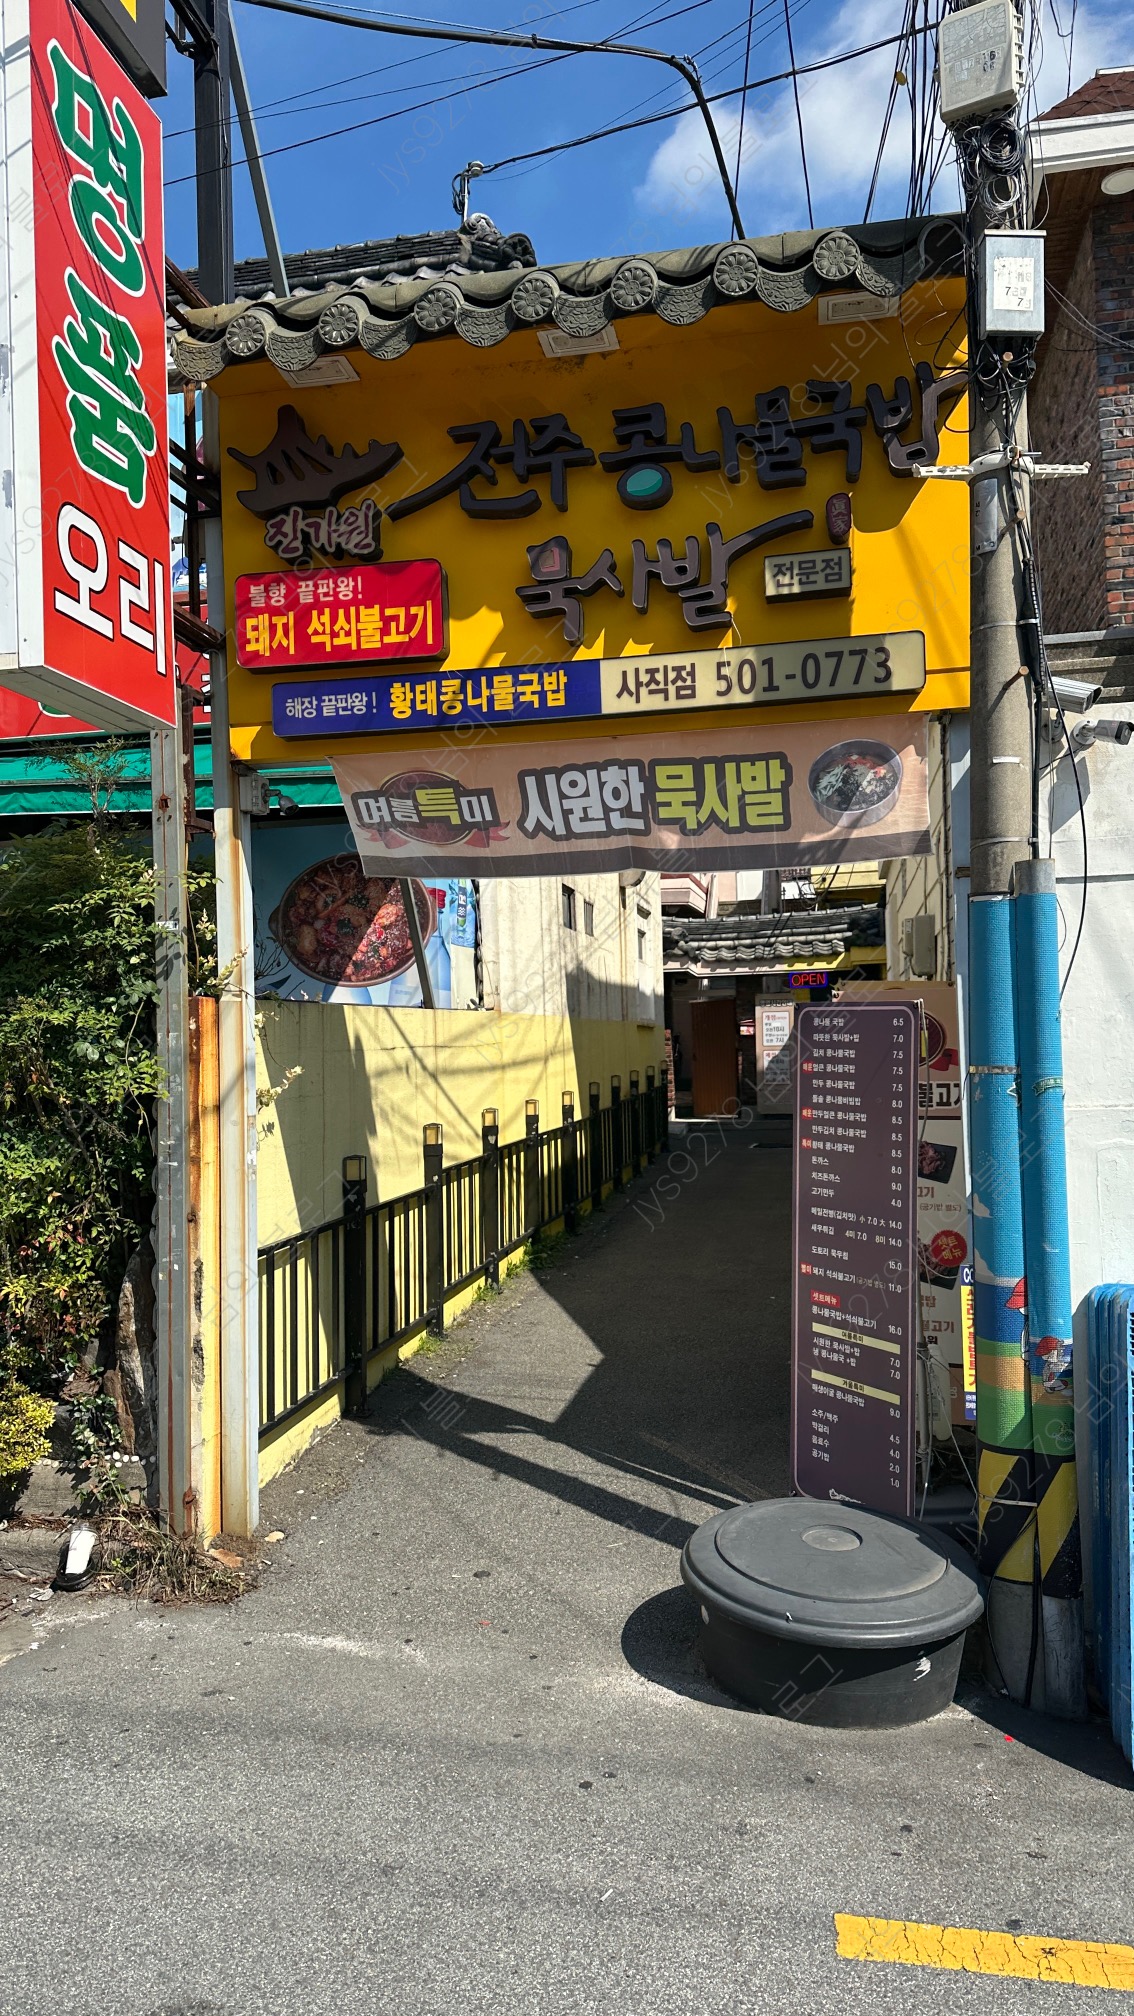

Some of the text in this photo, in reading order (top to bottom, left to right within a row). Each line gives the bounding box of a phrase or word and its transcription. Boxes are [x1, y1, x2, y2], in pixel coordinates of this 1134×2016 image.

[267, 500, 374, 554] 진가원
[515, 510, 814, 646] 묵사발
[772, 556, 843, 588] 전문점
[54, 502, 168, 676] 오리
[249, 576, 362, 607] 불향 끝판왕!
[246, 600, 433, 656] 돼지 석쇠불고기
[616, 647, 892, 703] 사직점 501-0773
[390, 670, 567, 719] 황태콩나물국밥
[286, 697, 317, 718] 해장
[523, 759, 786, 836] 시원한 묵사발
[791, 974, 826, 986] OPEN
[832, 1018, 844, 1027] 국밥
[893, 1018, 904, 1026] 6.5
[813, 1033, 830, 1042] 따뜻한
[893, 1034, 904, 1042] 7.0
[813, 1048, 824, 1057] 김치
[826, 1049, 856, 1058] 콩나물국밥
[826, 1064, 856, 1073] 콩나물국밥
[892, 1066, 903, 1074] 7.5
[812, 1080, 902, 1092] 만두 콩나물국밥 7.5
[826, 1095, 861, 1106] 콩나물비빔밥
[892, 1100, 902, 1108] 8.0
[837, 1112, 867, 1122] 콩나물국밥
[892, 1116, 902, 1124] 8.5
[812, 1125, 902, 1141] 만두김치 콩나물국밥 8.5
[825, 1142, 855, 1153] 콩나물국밥
[891, 1149, 902, 1157] 8.5
[812, 1156, 902, 1174] 돈까스 8.0
[811, 1172, 902, 1191] 치즈돈까스 9.0
[811, 1187, 902, 1208] 고기만두 4.0
[859, 1216, 865, 1224] 小
[867, 1216, 877, 1225] 7.0
[879, 1219, 886, 1227] 大
[889, 1221, 902, 1230] 14.0
[811, 1224, 834, 1235] 새우튀김
[857, 1232, 867, 1240] 7.0
[875, 1235, 886, 1245] 8미
[889, 1238, 902, 1247] 14.0
[812, 1246, 829, 1256] 도토리
[889, 1261, 902, 1270] 15.0
[812, 1267, 824, 1276] 돼지
[826, 1270, 856, 1284] 석쇠불고기
[889, 1284, 902, 1293] 11.0
[813, 1292, 837, 1305] 셋트메뉴
[888, 1325, 902, 1335] 16.0
[813, 1337, 831, 1348] 시원한
[890, 1358, 900, 1368] 7.0
[890, 1370, 900, 1380] 7.0
[836, 1390, 865, 1407] 콩나물국밥
[889, 1408, 900, 1418] 9.0
[812, 1408, 900, 1444] 소주/맥주 4.5
[812, 1421, 900, 1459] 막걸리 4.0
[812, 1435, 900, 1473] 음료수 2.0
[812, 1448, 900, 1487] 공기밥 1.0
